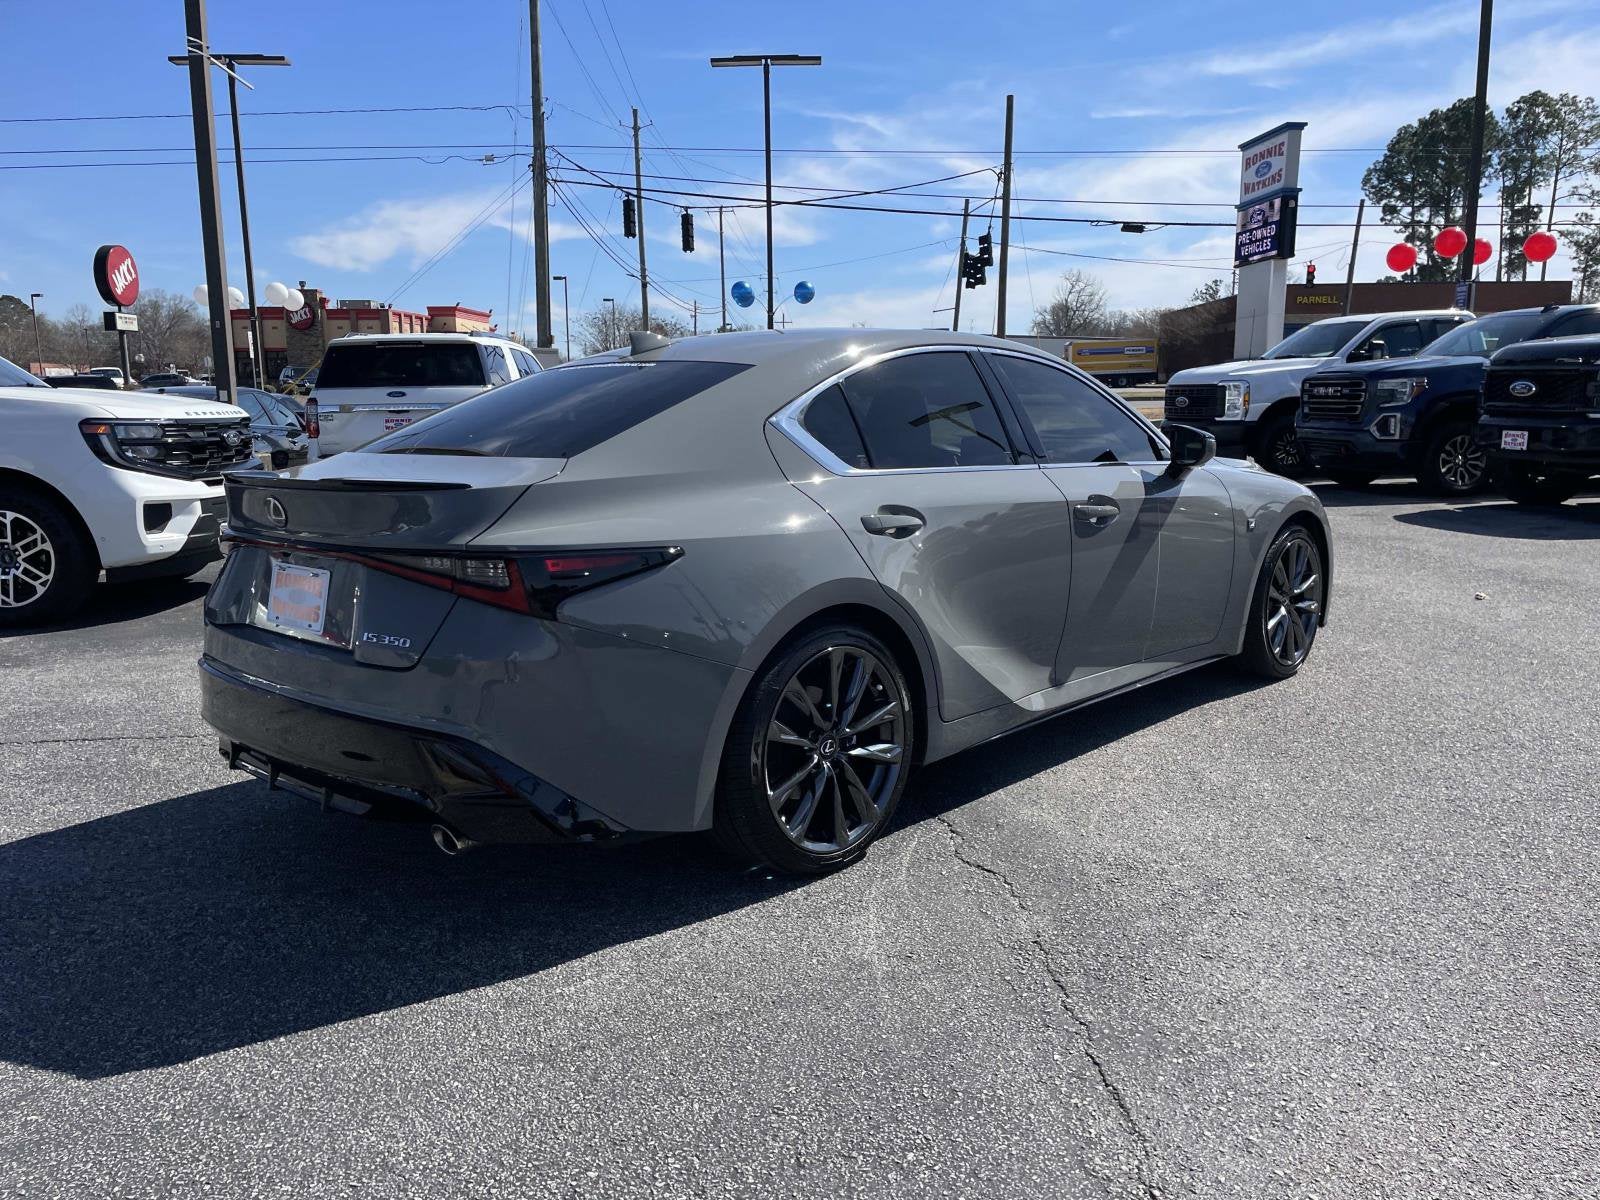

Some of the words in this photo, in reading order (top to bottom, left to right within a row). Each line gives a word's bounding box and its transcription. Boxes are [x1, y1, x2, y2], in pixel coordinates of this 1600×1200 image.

[1244, 141, 1285, 171] RONNIE
[1243, 168, 1283, 195] WATKINS
[1238, 224, 1276, 245] PRE-OWNED
[1241, 238, 1271, 256] VEHICLES
[1296, 295, 1339, 304] PARNELL
